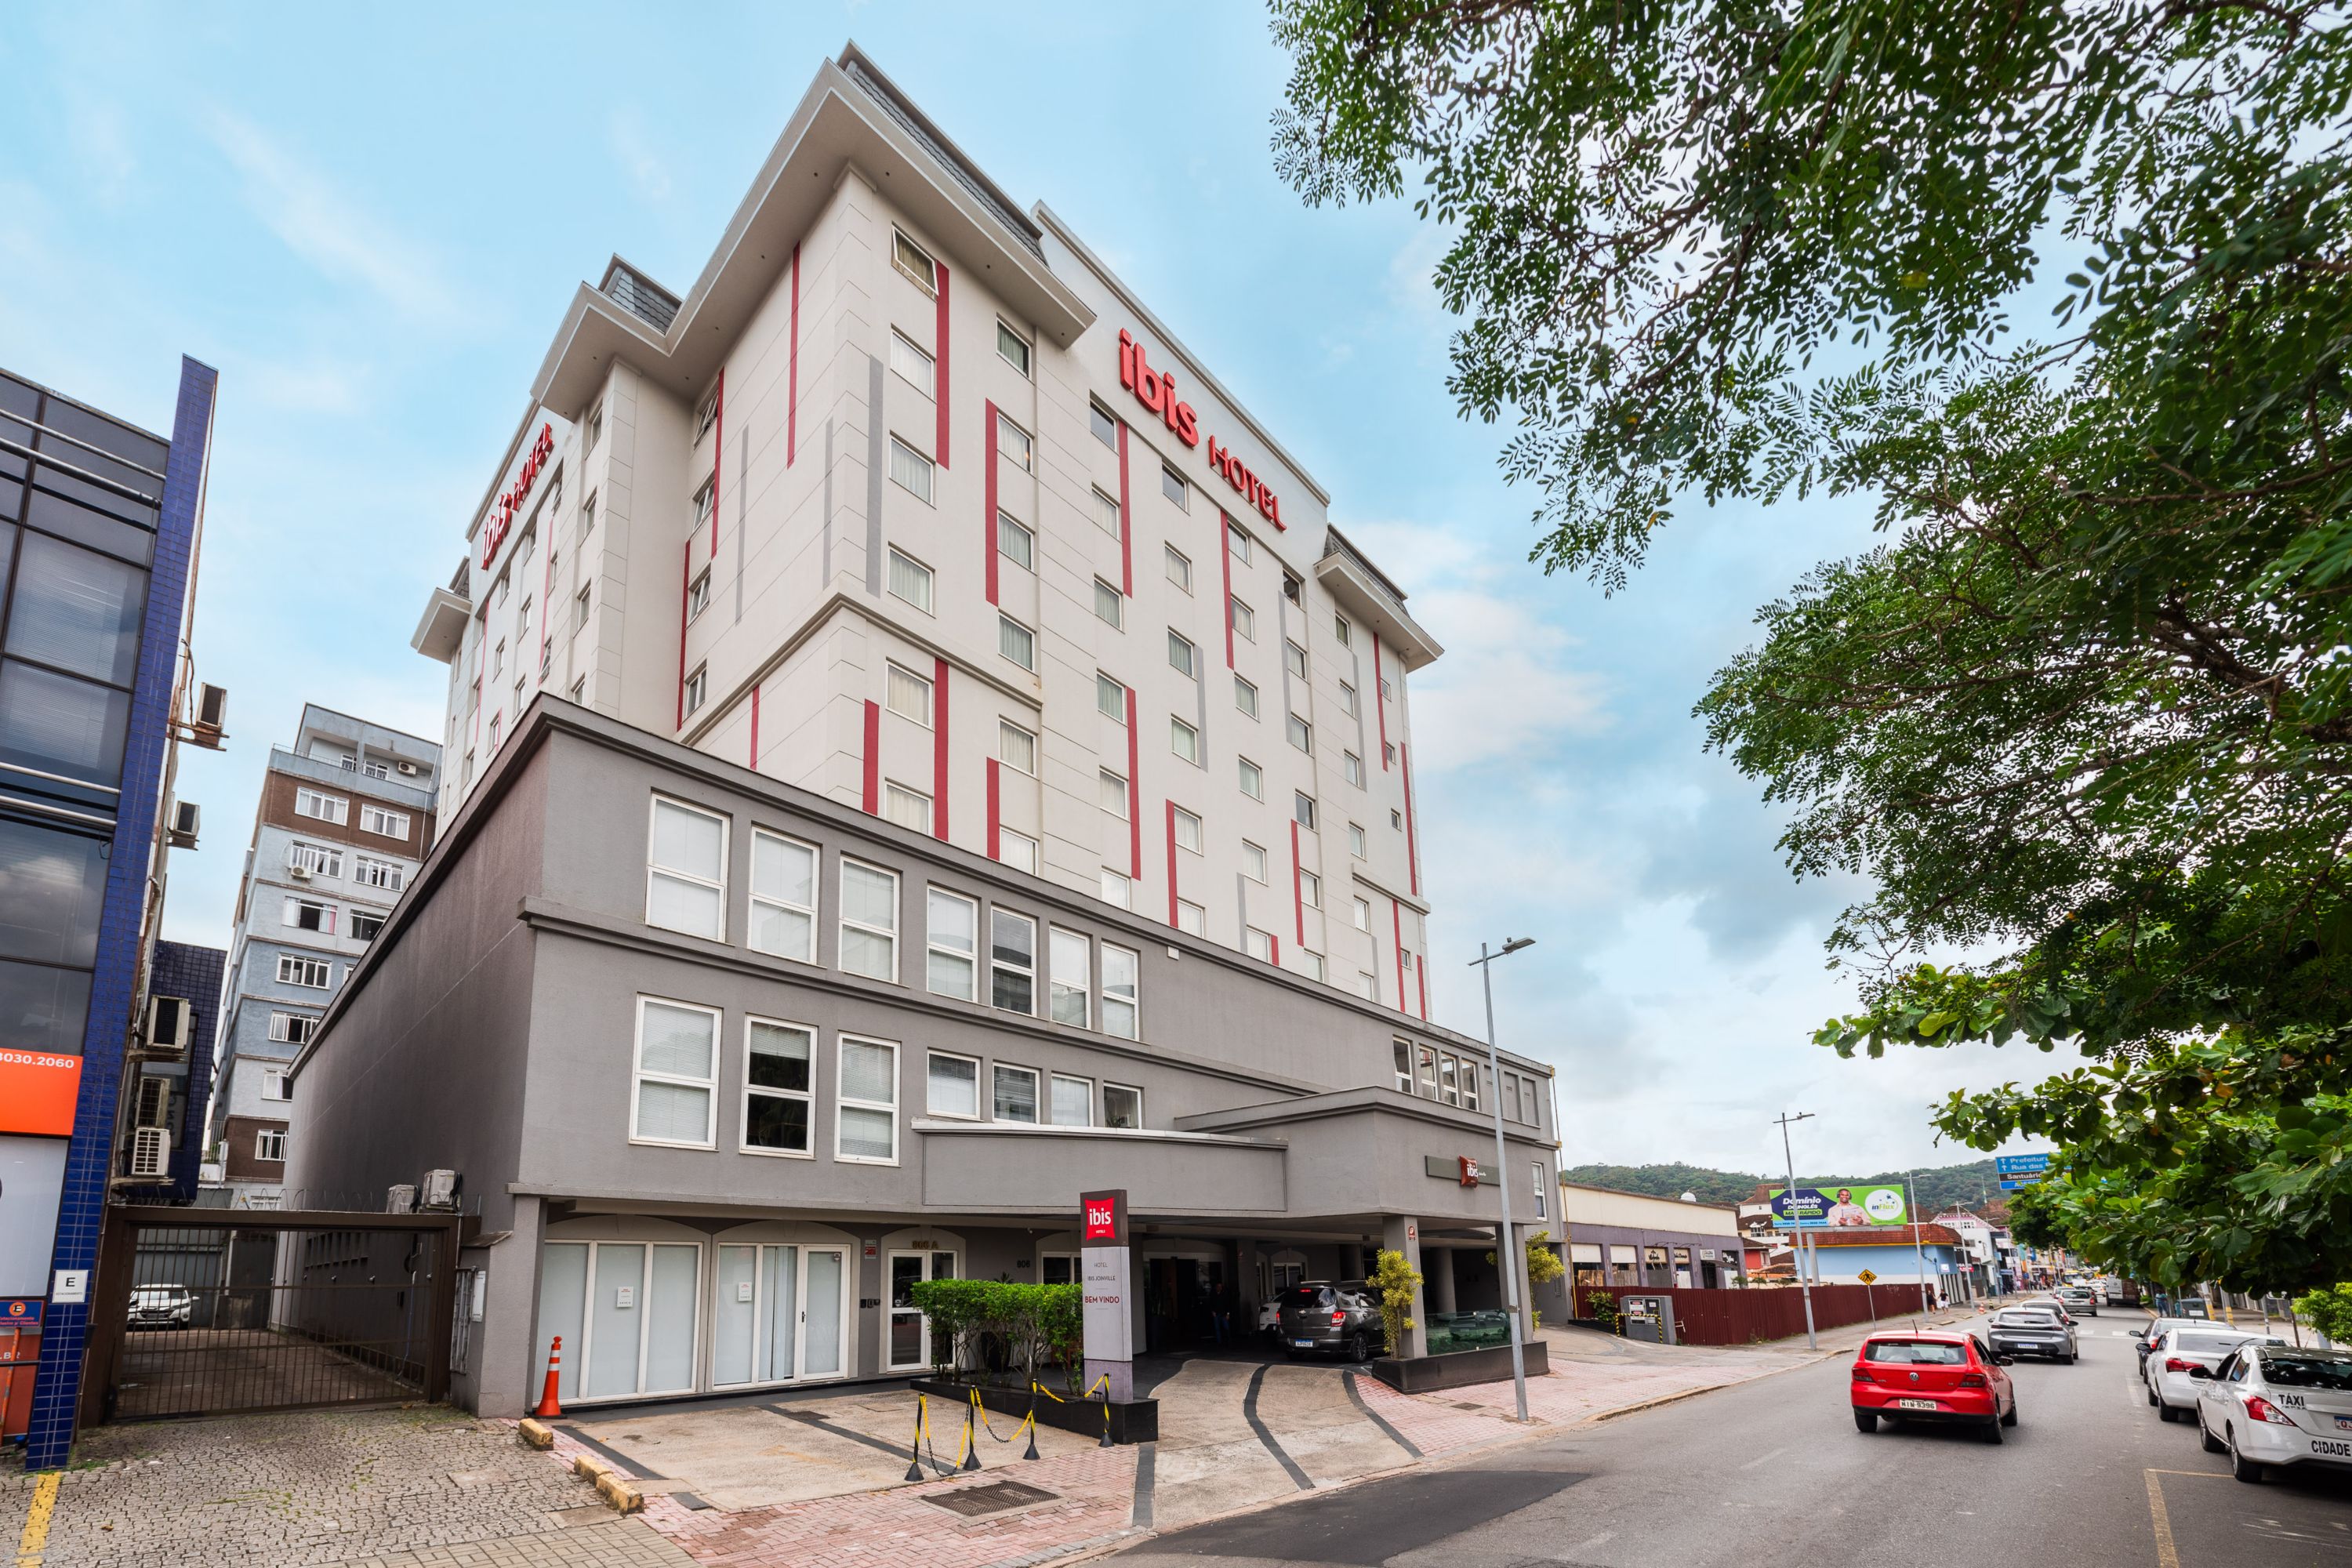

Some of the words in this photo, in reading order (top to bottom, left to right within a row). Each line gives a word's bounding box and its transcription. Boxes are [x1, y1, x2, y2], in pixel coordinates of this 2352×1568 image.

[1119, 328, 1199, 448] ibis
[1208, 435, 1287, 532] HOTEL
[1089, 1207, 1111, 1225] ibis
[66, 1277, 75, 1287] E
[2278, 1393, 2305, 1406] TÁXI
[2311, 1440, 2351, 1457] CIDADE
